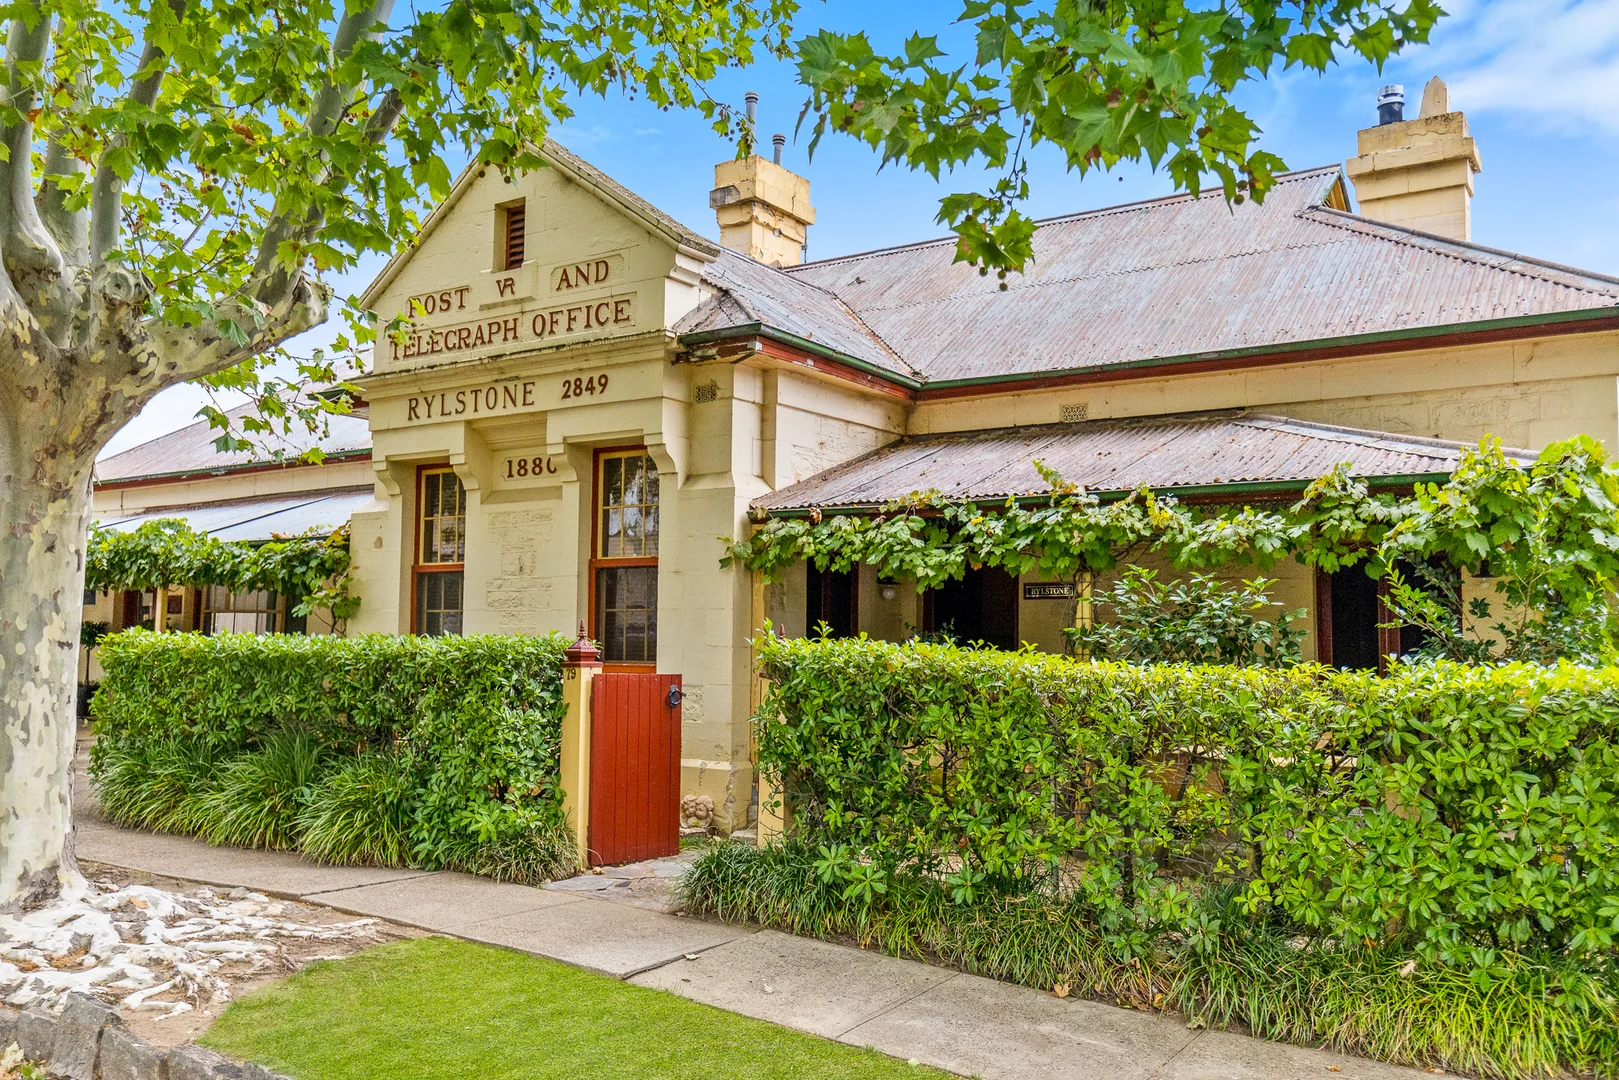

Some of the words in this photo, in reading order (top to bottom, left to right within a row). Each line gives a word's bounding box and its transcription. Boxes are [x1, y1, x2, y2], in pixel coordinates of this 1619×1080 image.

[408, 287, 470, 319] POST
[556, 259, 609, 292] AND
[495, 277, 516, 298] VR
[389, 317, 519, 361] TELEGRAPH
[532, 299, 631, 337] OFFICE
[407, 381, 536, 421] RYLSTONE
[561, 373, 609, 400] 2849
[1030, 587, 1069, 595] RYLSTONE
[565, 667, 577, 681] 79
